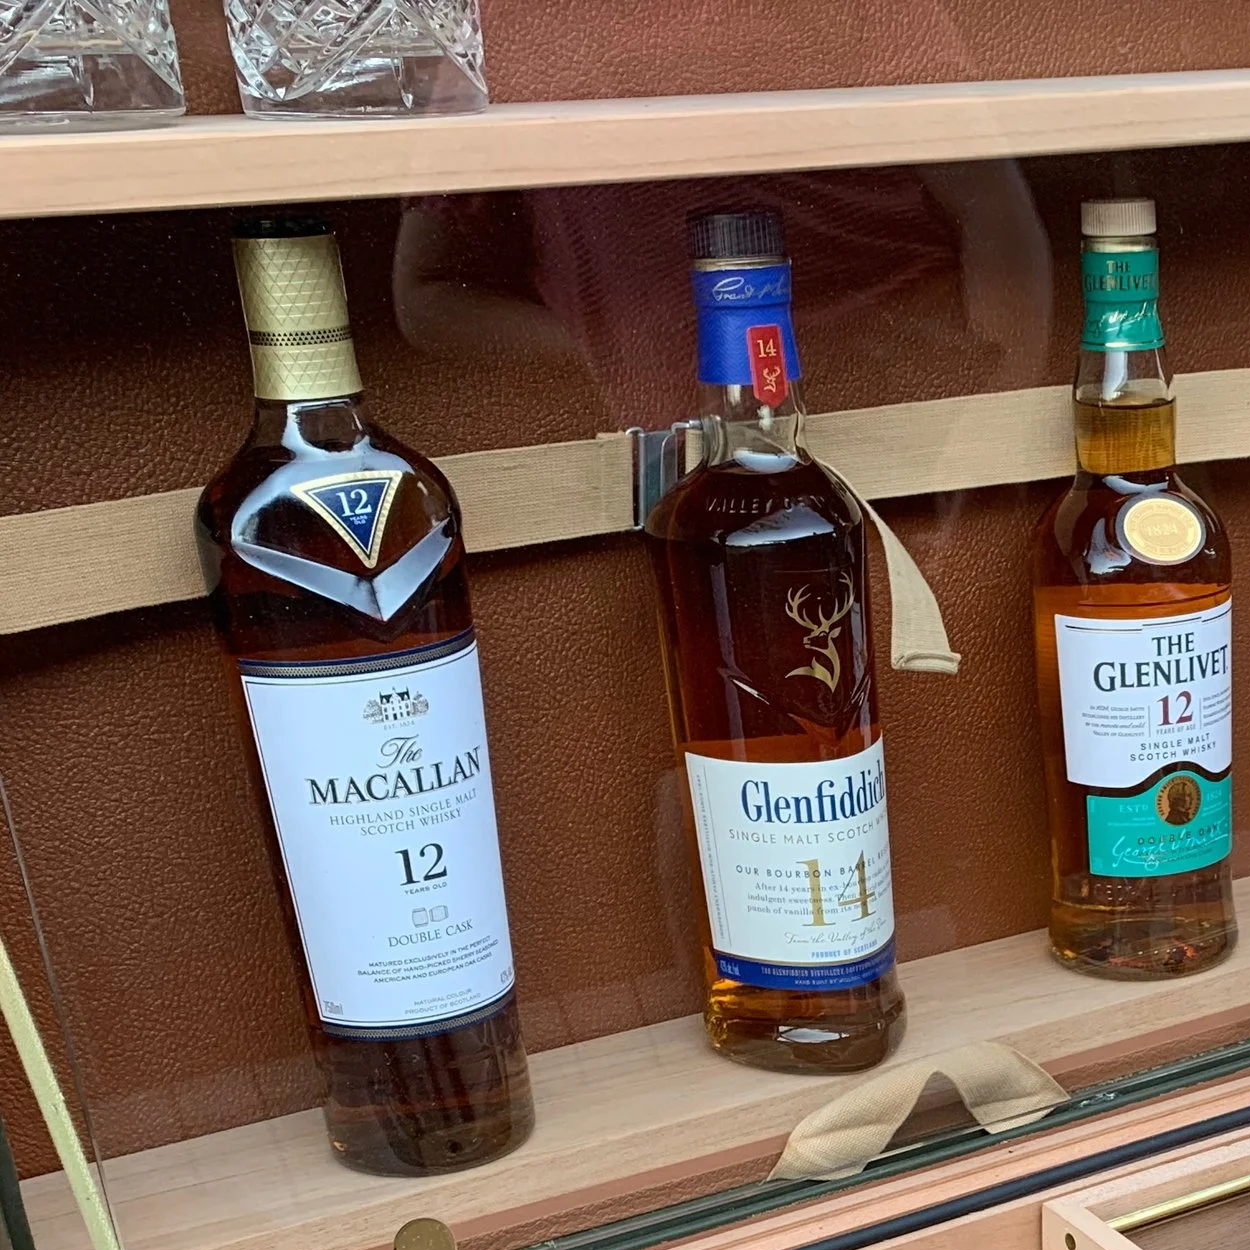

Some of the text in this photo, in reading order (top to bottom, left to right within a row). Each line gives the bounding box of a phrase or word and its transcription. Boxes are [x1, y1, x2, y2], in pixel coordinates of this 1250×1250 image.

[1106, 260, 1130, 273] THE
[757, 339, 777, 358] 14
[335, 488, 372, 517] 12
[1151, 631, 1195, 657] THE
[1093, 644, 1229, 692] GLENLIVET
[1157, 690, 1194, 726] 12
[1140, 732, 1210, 751] SINGLE MALT
[1156, 727, 1175, 735] YEARS
[376, 734, 423, 769] The
[1130, 741, 1217, 762] SCOTCH WHISKY
[305, 745, 481, 804] MACALLAN
[741, 760, 886, 824] Glenfiddich
[329, 788, 477, 826] HIGHLAND SINGLE MALT
[360, 807, 462, 836] SCOTCH WHISKY
[729, 820, 874, 845] SINGLE MALT SCOTCH
[394, 842, 448, 886] 12
[735, 864, 760, 876] OUR
[766, 868, 832, 879] BOURBON
[404, 881, 448, 895] YEARS OLD
[755, 882, 776, 891] After
[778, 884, 789, 892] 14
[795, 849, 877, 927] 14
[747, 894, 789, 905] indulgent
[747, 904, 771, 914] punch
[772, 906, 782, 914] of
[388, 918, 473, 947] DOUBLE CASK
[357, 968, 391, 976] BALANCE
[403, 958, 451, 973] HAND-PICKED
[369, 959, 403, 967] MATURED
[404, 951, 449, 965] EXCLUSIVELY
[457, 945, 469, 953] THE
[374, 975, 411, 984] AMERICAN
[412, 972, 428, 980] AND
[428, 963, 464, 977] EUROPEAN
